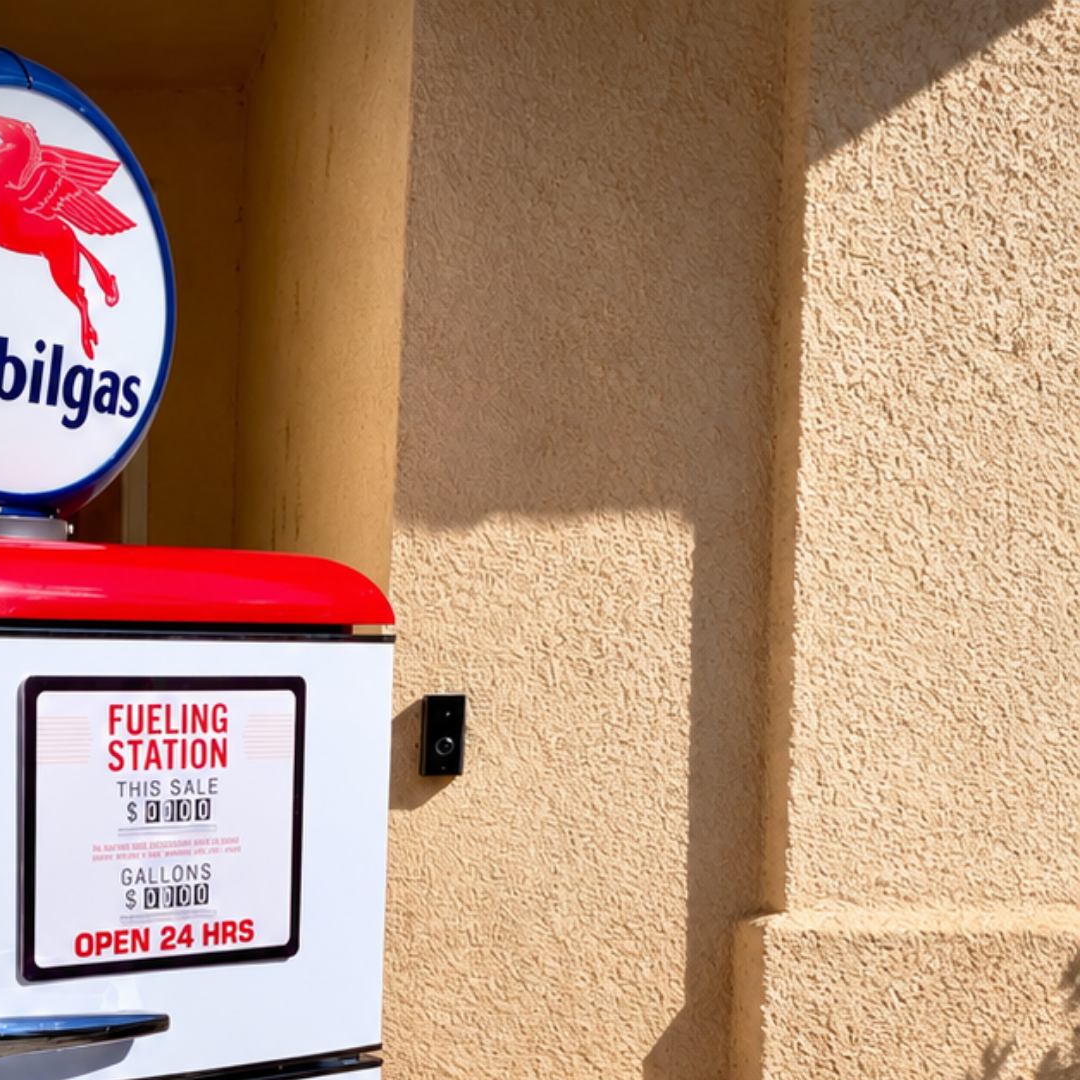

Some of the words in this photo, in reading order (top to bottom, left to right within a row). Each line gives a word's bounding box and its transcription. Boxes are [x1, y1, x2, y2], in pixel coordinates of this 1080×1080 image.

[109, 703, 227, 735] FUELING
[109, 738, 227, 771] STATION
[117, 780, 161, 798] THIS
[170, 777, 219, 796] SALE
[126, 800, 138, 823] $
[122, 864, 211, 886] GALLONS
[75, 928, 149, 957] OPEN
[161, 924, 194, 950] 24
[203, 919, 254, 945] HRS
